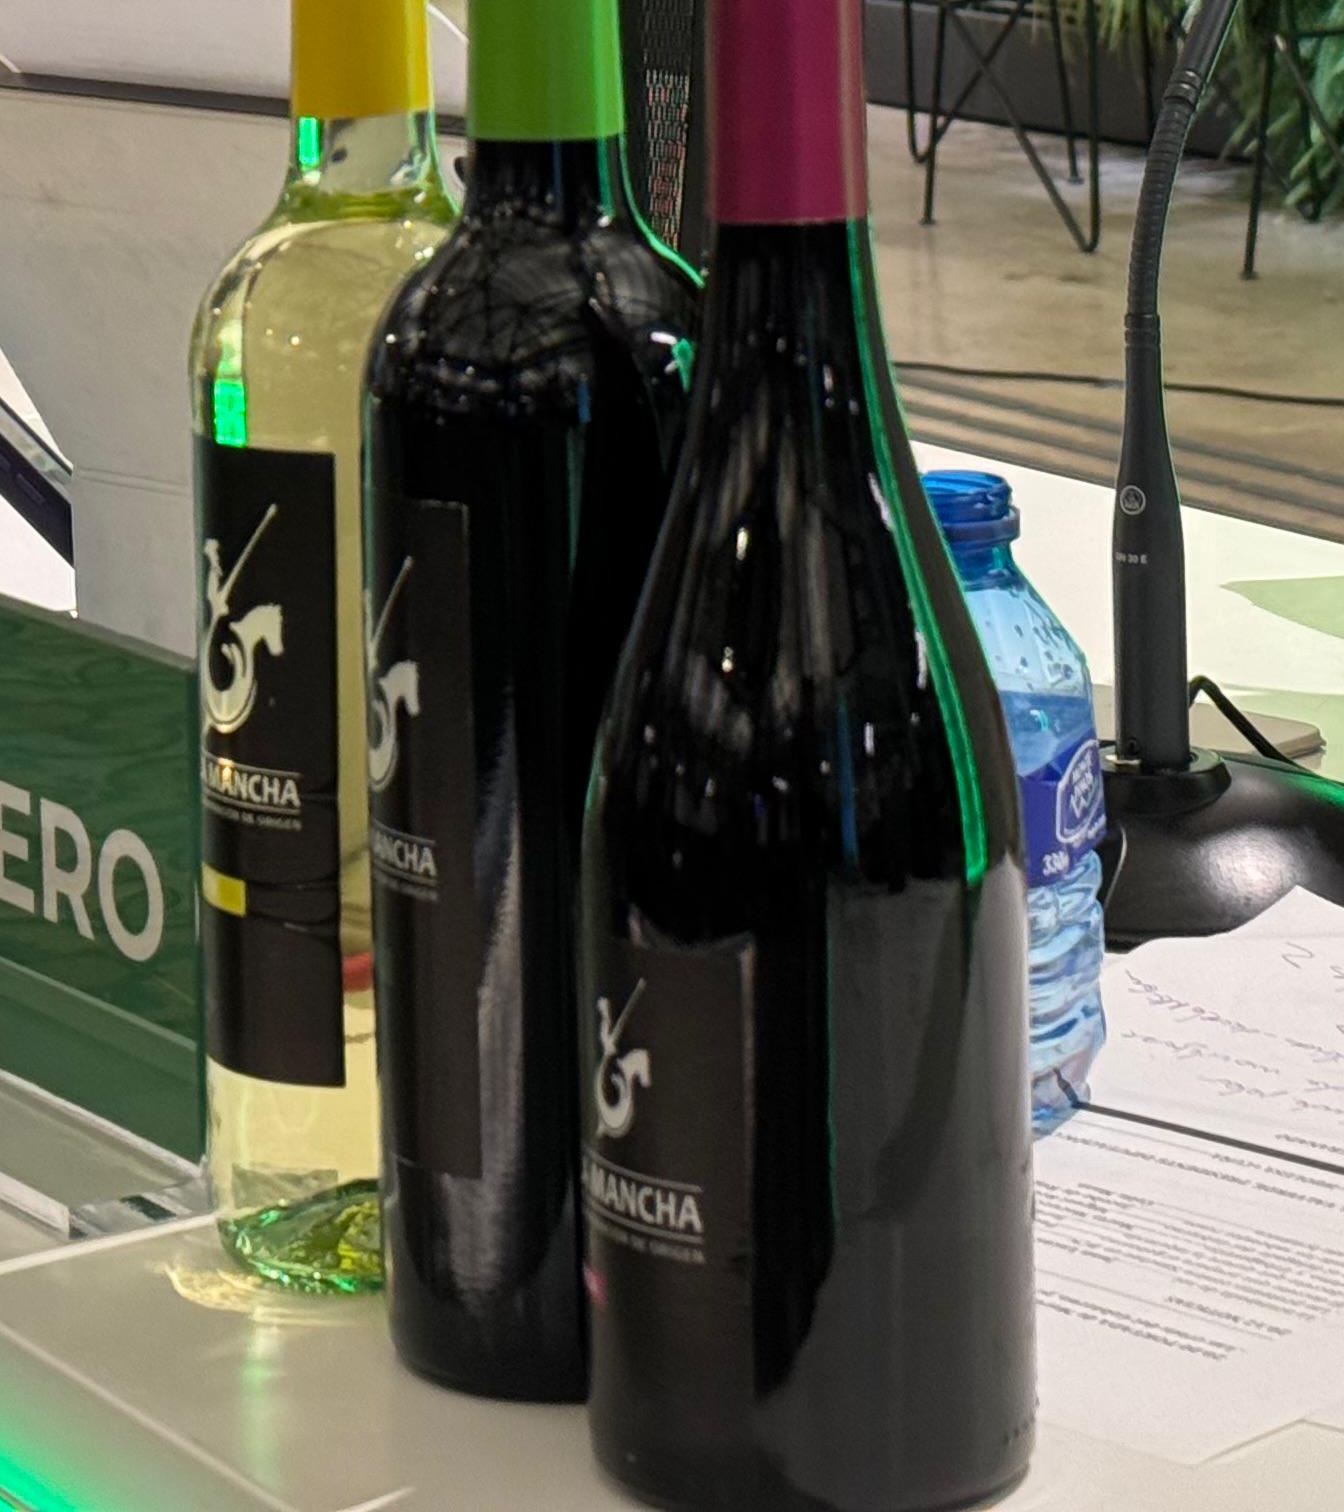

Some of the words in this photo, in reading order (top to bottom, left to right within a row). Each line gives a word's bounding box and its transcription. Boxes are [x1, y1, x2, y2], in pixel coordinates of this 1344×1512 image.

[207, 760, 302, 808] MANCHA
[372, 830, 438, 878] ANCHA
[590, 1161, 704, 1234] MANCHA
